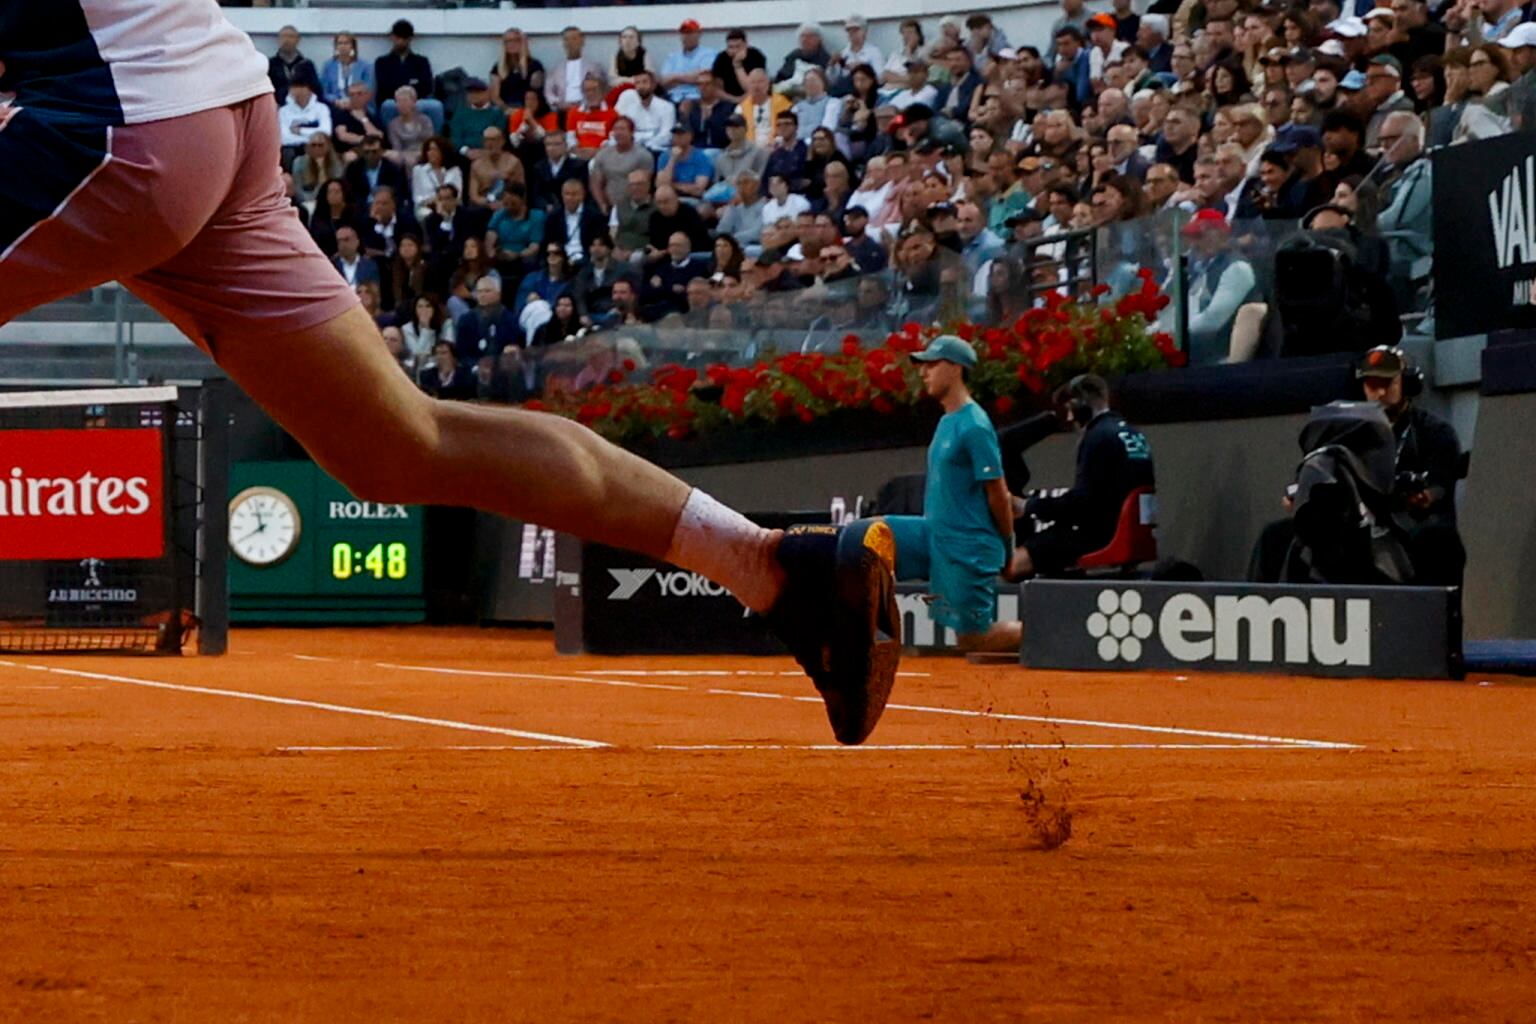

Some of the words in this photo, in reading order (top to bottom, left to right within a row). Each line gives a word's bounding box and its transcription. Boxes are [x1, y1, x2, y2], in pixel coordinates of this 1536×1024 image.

[329, 501, 408, 519] ROLEX
[333, 542, 407, 579] 0:48
[654, 571, 733, 596] YOKO
[1159, 592, 1371, 666] emu
